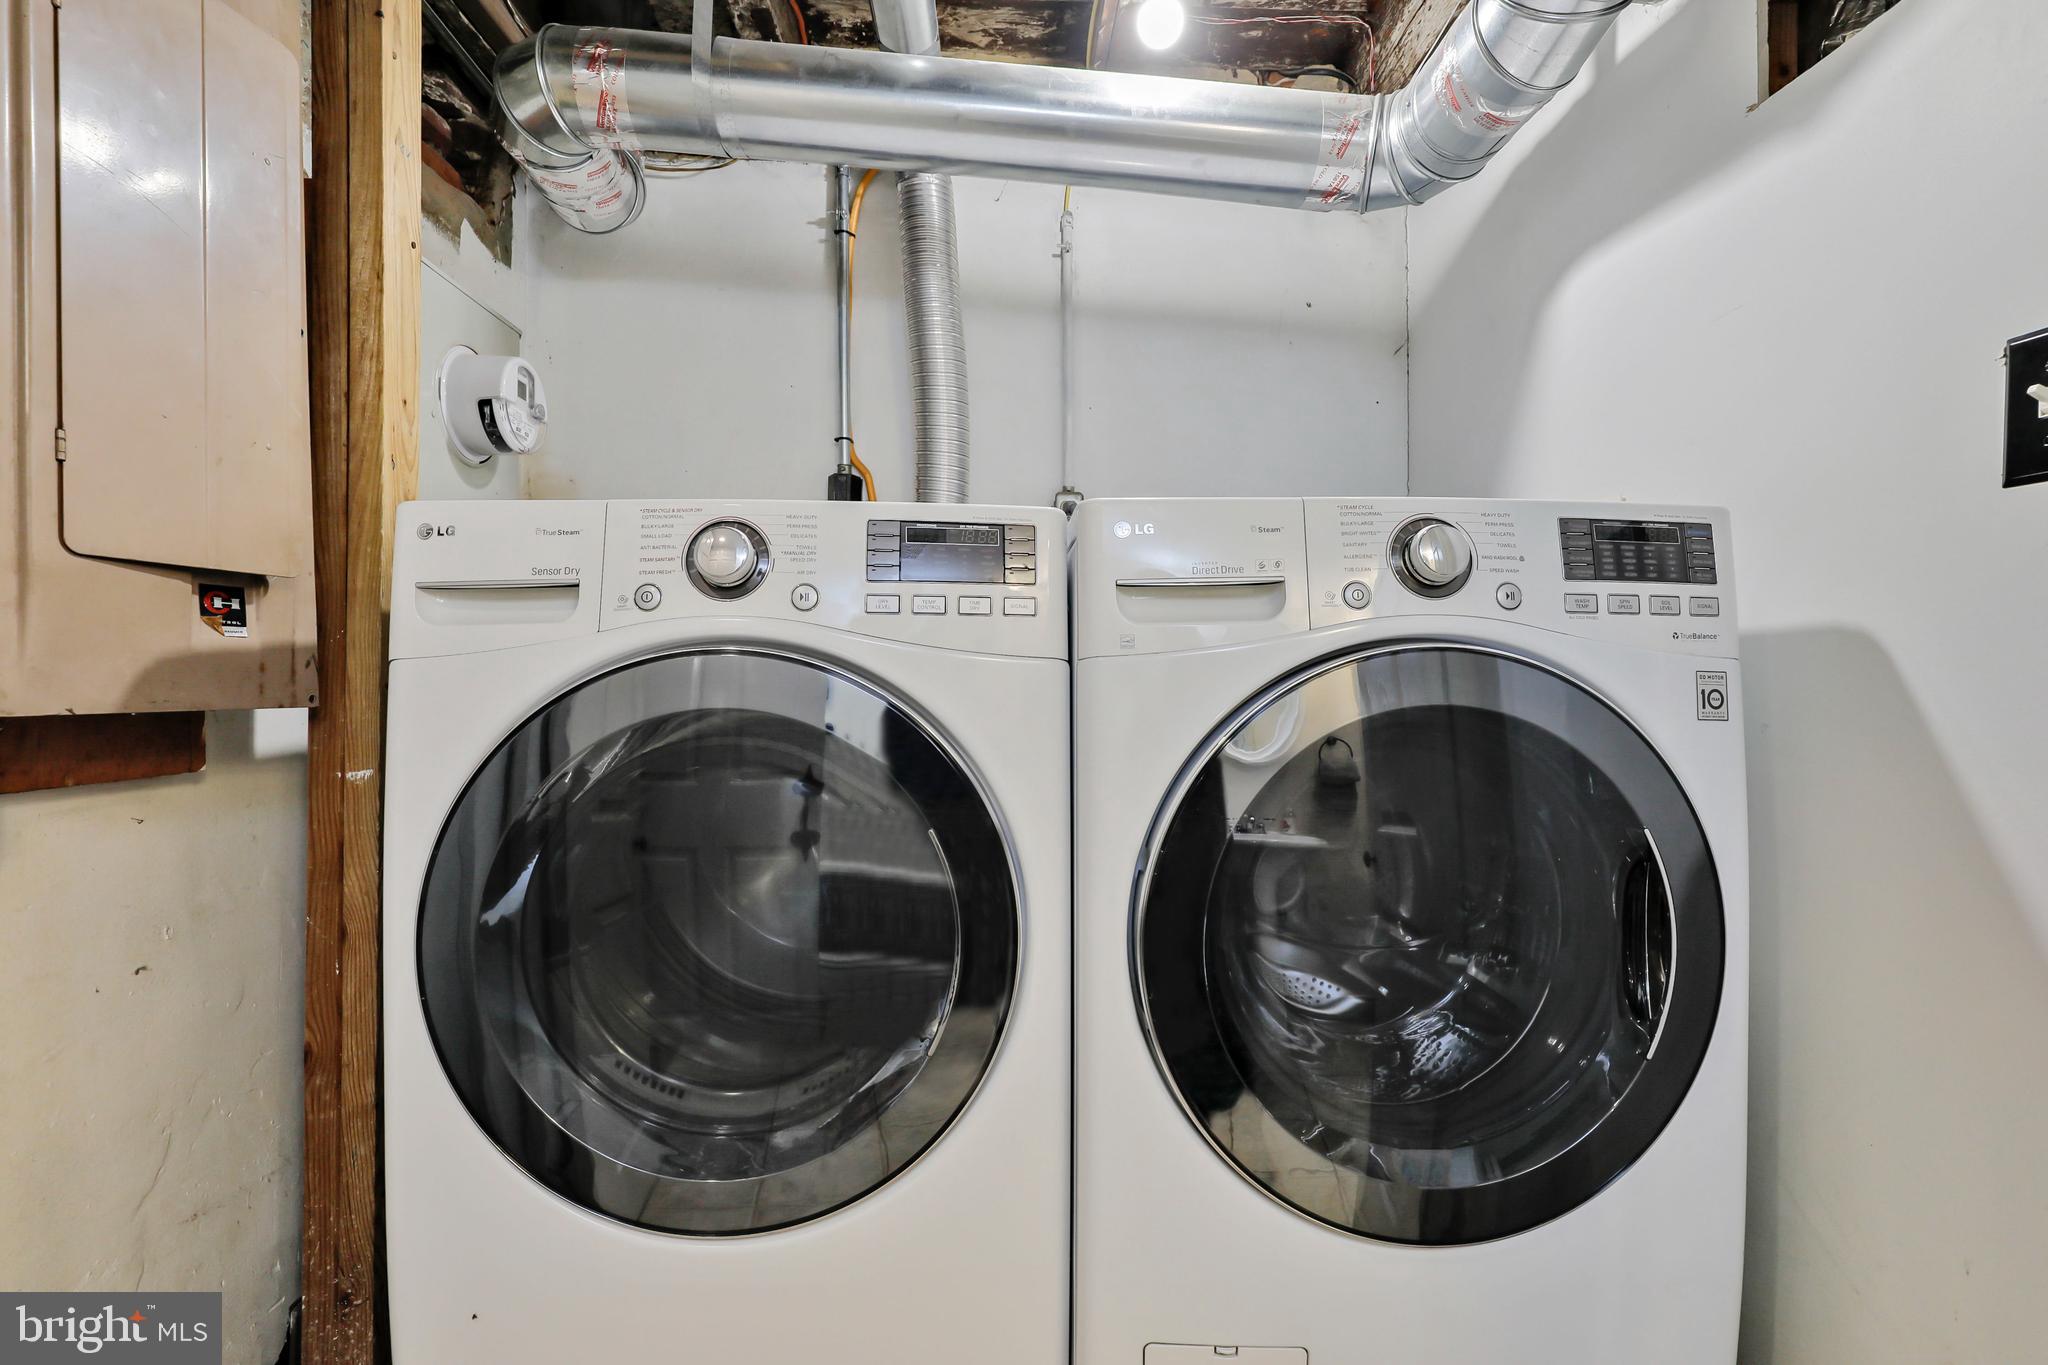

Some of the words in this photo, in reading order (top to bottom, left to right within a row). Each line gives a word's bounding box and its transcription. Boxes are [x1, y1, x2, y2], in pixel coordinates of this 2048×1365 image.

[436, 525, 456, 537] LG
[1135, 523, 1154, 535] LG
[531, 566, 562, 576] Sensor
[564, 566, 581, 578] Dry
[1680, 632, 1718, 640] TrueBalance
[1701, 688, 1724, 710] 10
